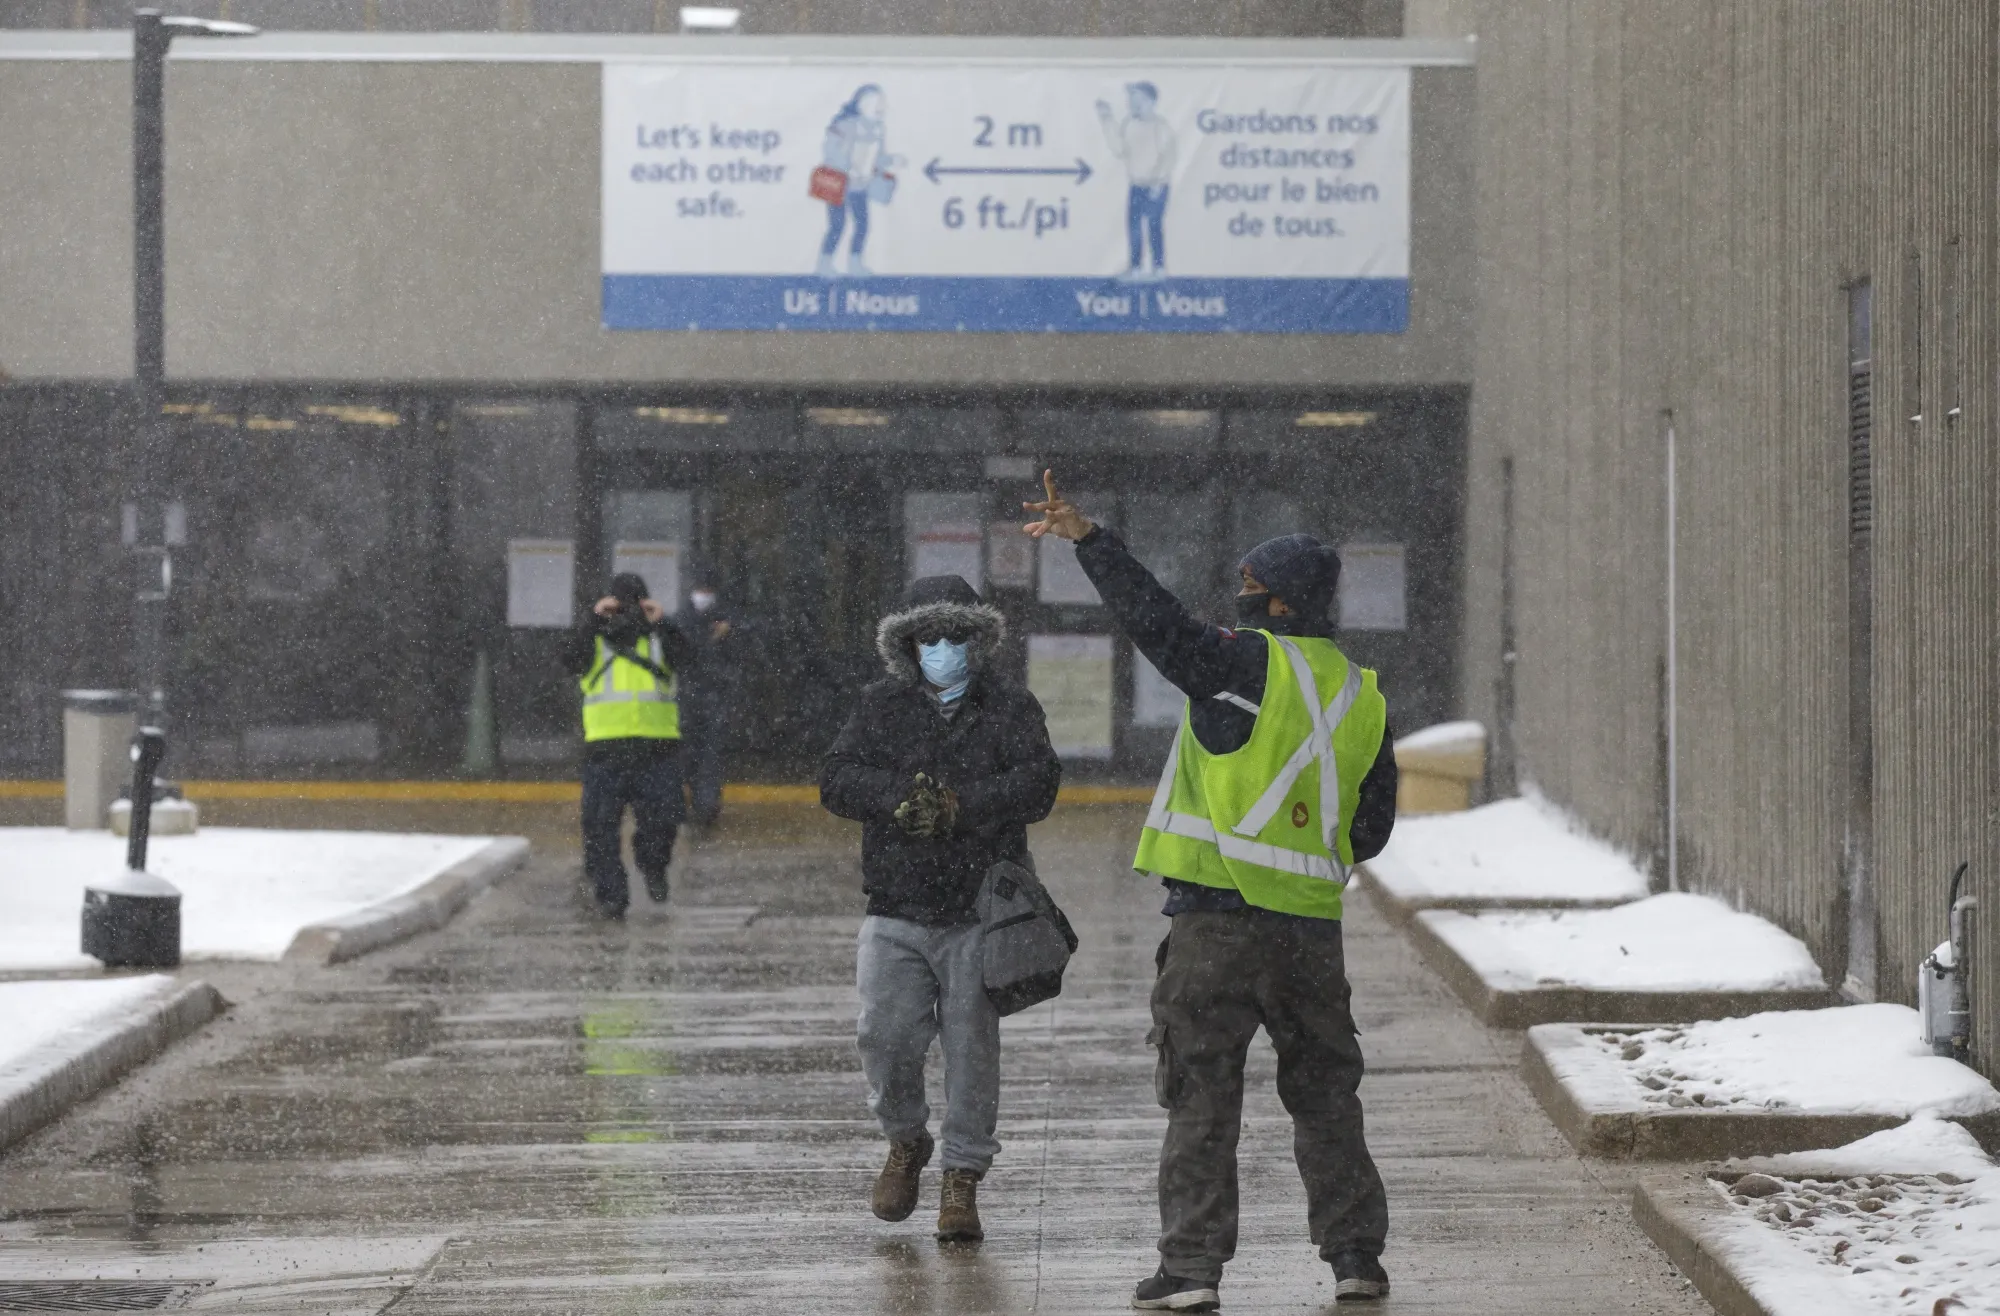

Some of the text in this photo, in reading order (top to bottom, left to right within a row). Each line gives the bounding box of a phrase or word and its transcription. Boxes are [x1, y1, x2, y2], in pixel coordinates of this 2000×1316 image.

[973, 115, 1043, 147] 2 m
[1196, 108, 1380, 136] Gardons nos
[636, 123, 782, 155] Let's keep
[630, 158, 786, 184] each other
[1219, 143, 1356, 171] distances
[676, 192, 744, 219] safe.
[1203, 176, 1380, 209] pour le bien
[941, 195, 1069, 239] 6 ft./pi
[1227, 211, 1346, 239] de tous.
[783, 289, 920, 316] Us Nous
[1076, 291, 1227, 317] You Vous
